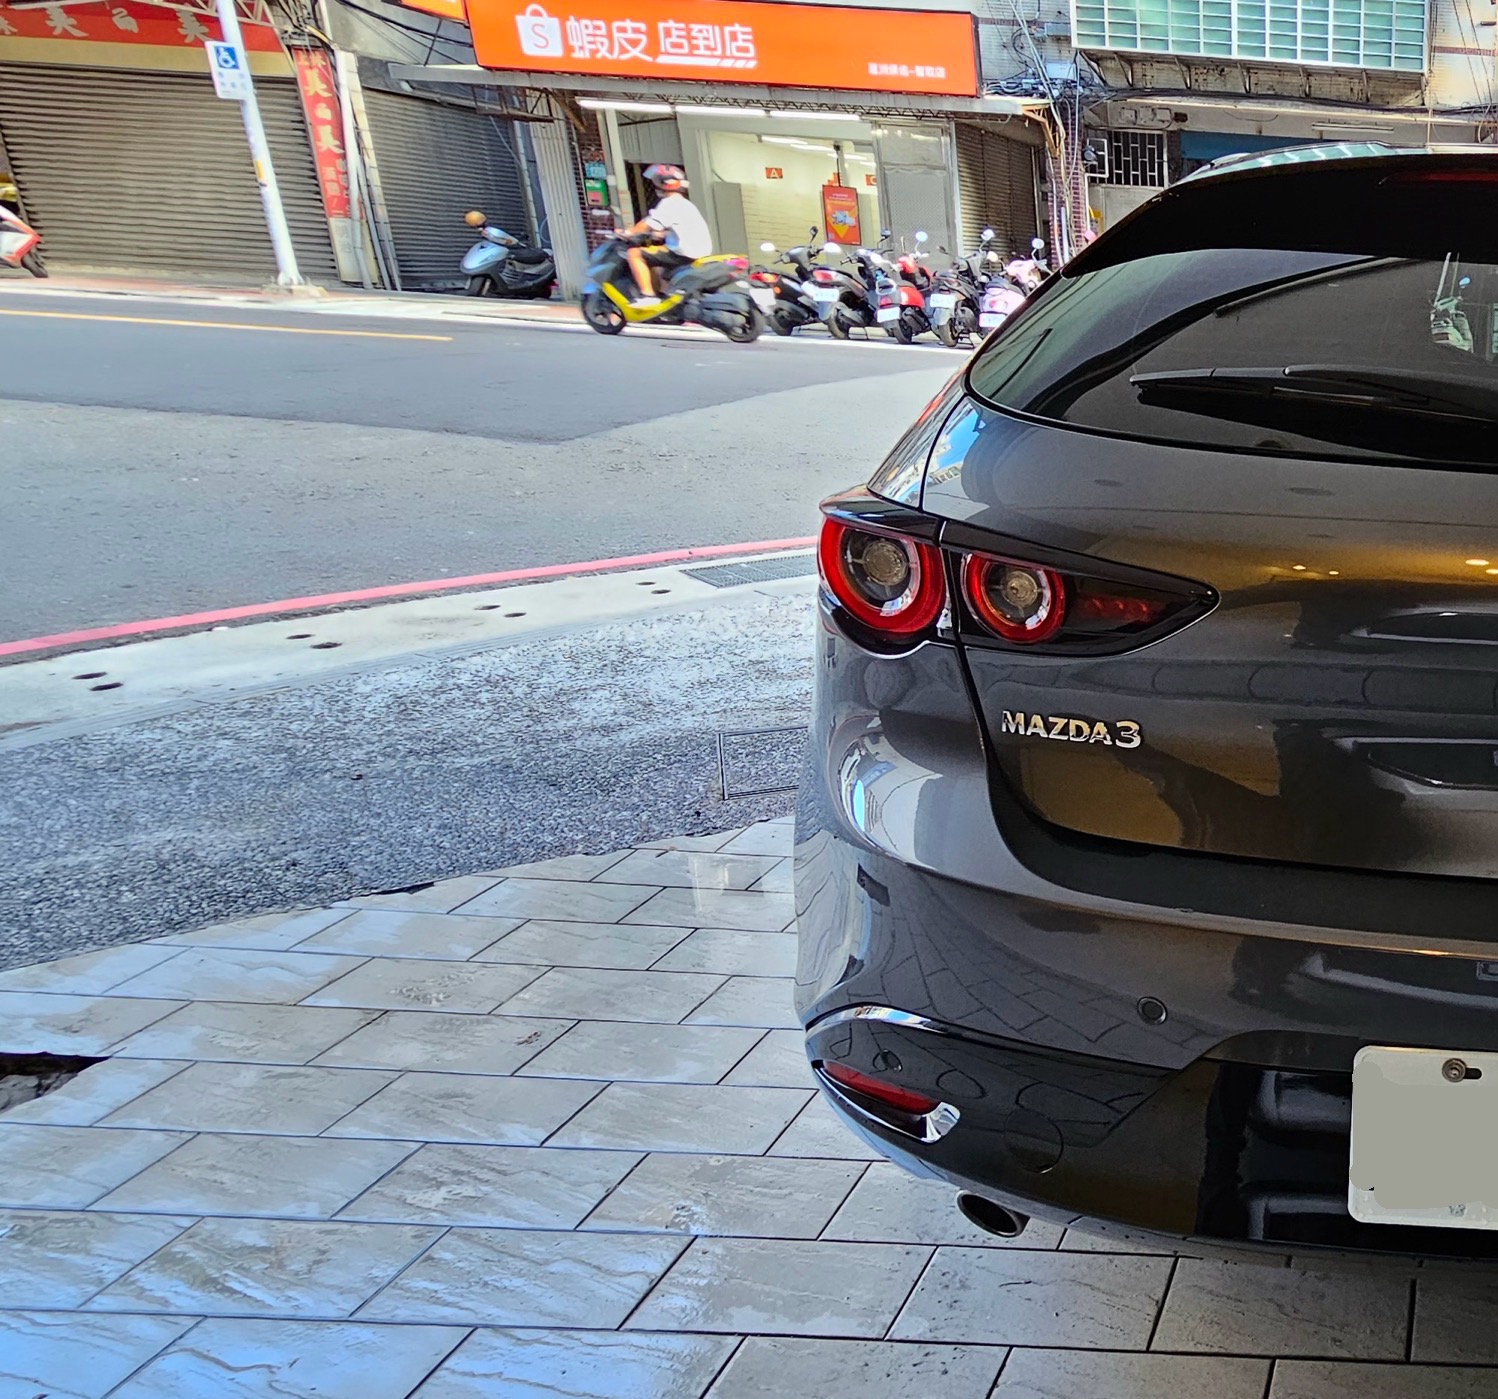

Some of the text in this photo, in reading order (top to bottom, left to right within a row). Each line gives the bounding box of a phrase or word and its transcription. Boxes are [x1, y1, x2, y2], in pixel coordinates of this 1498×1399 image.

[566, 15, 653, 62] 蝦皮
[657, 19, 756, 58] 店到店
[770, 168, 780, 179] A
[1001, 710, 1142, 749] MAZDA3
